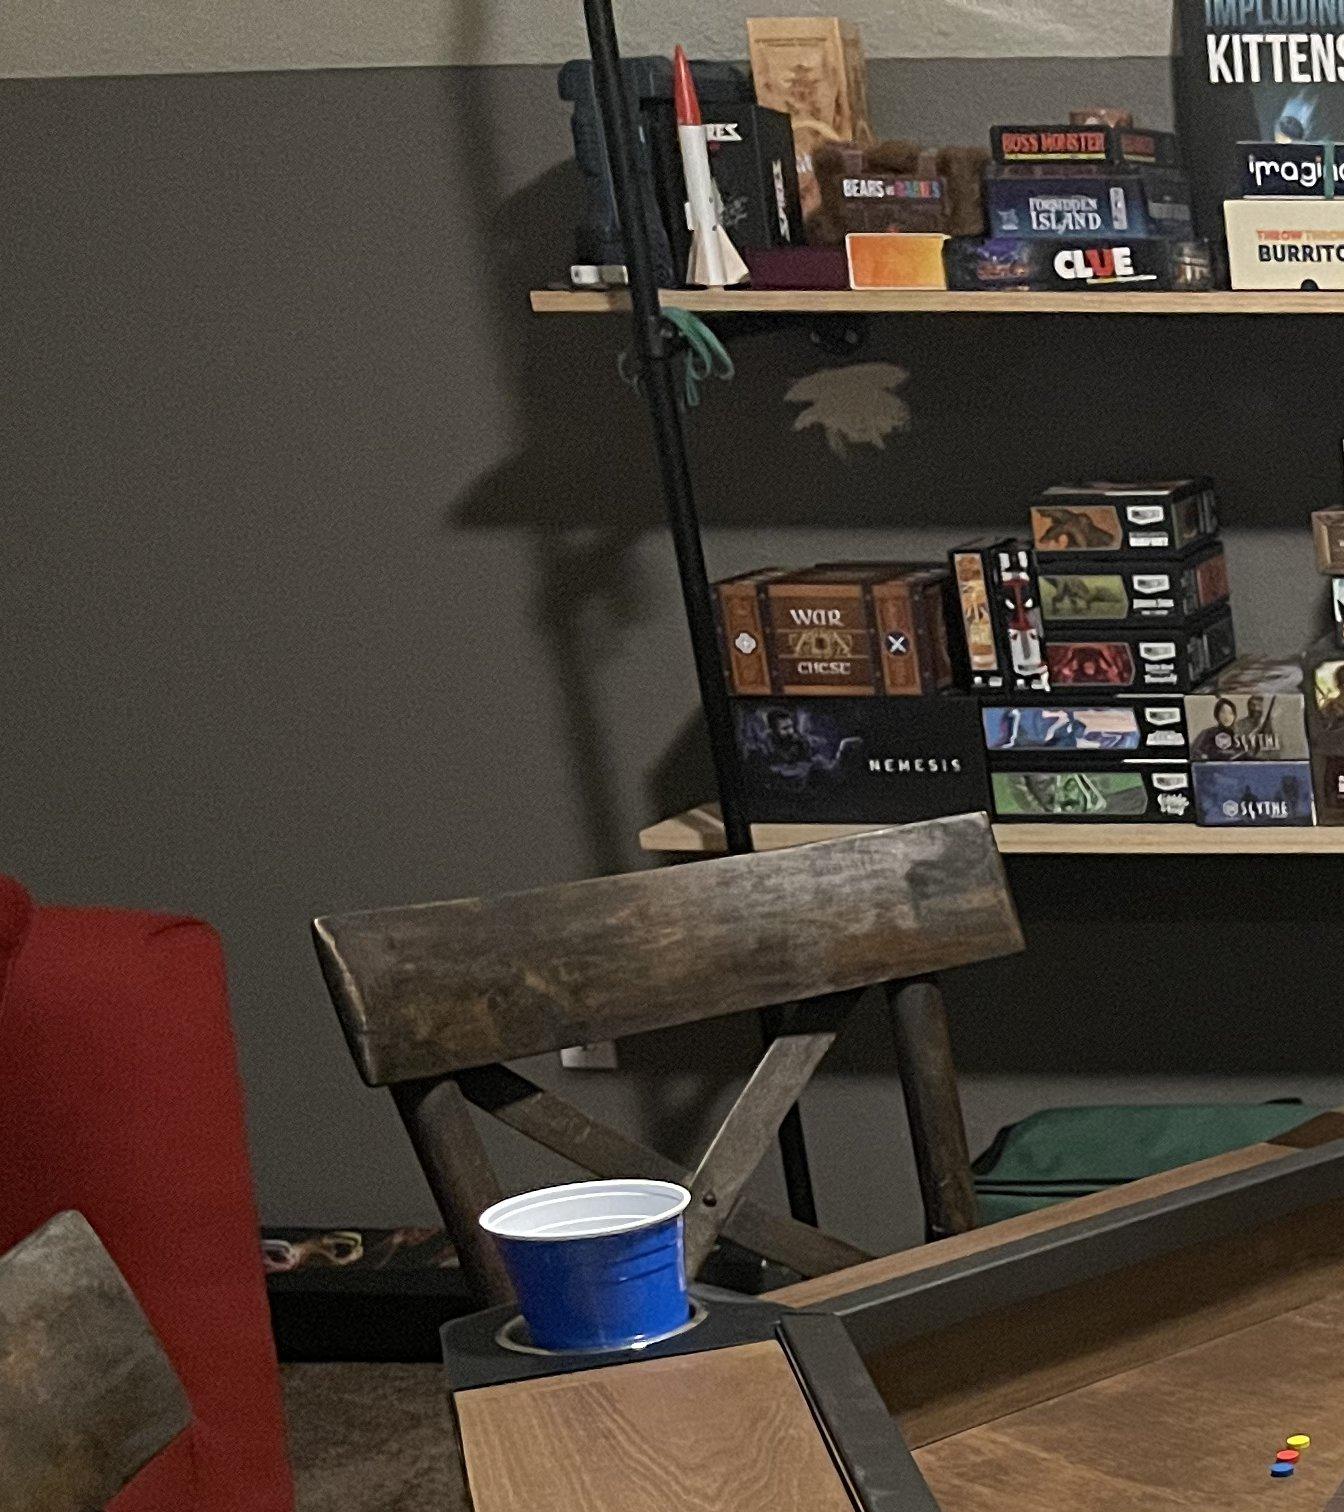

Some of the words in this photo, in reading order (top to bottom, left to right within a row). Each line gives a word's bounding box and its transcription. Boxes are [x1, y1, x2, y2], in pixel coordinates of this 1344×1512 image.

[1031, 211, 1102, 234] ISLAND
[1053, 247, 1135, 280] CLUE
[789, 608, 845, 628] WAR
[869, 758, 962, 773] NEMESIS
